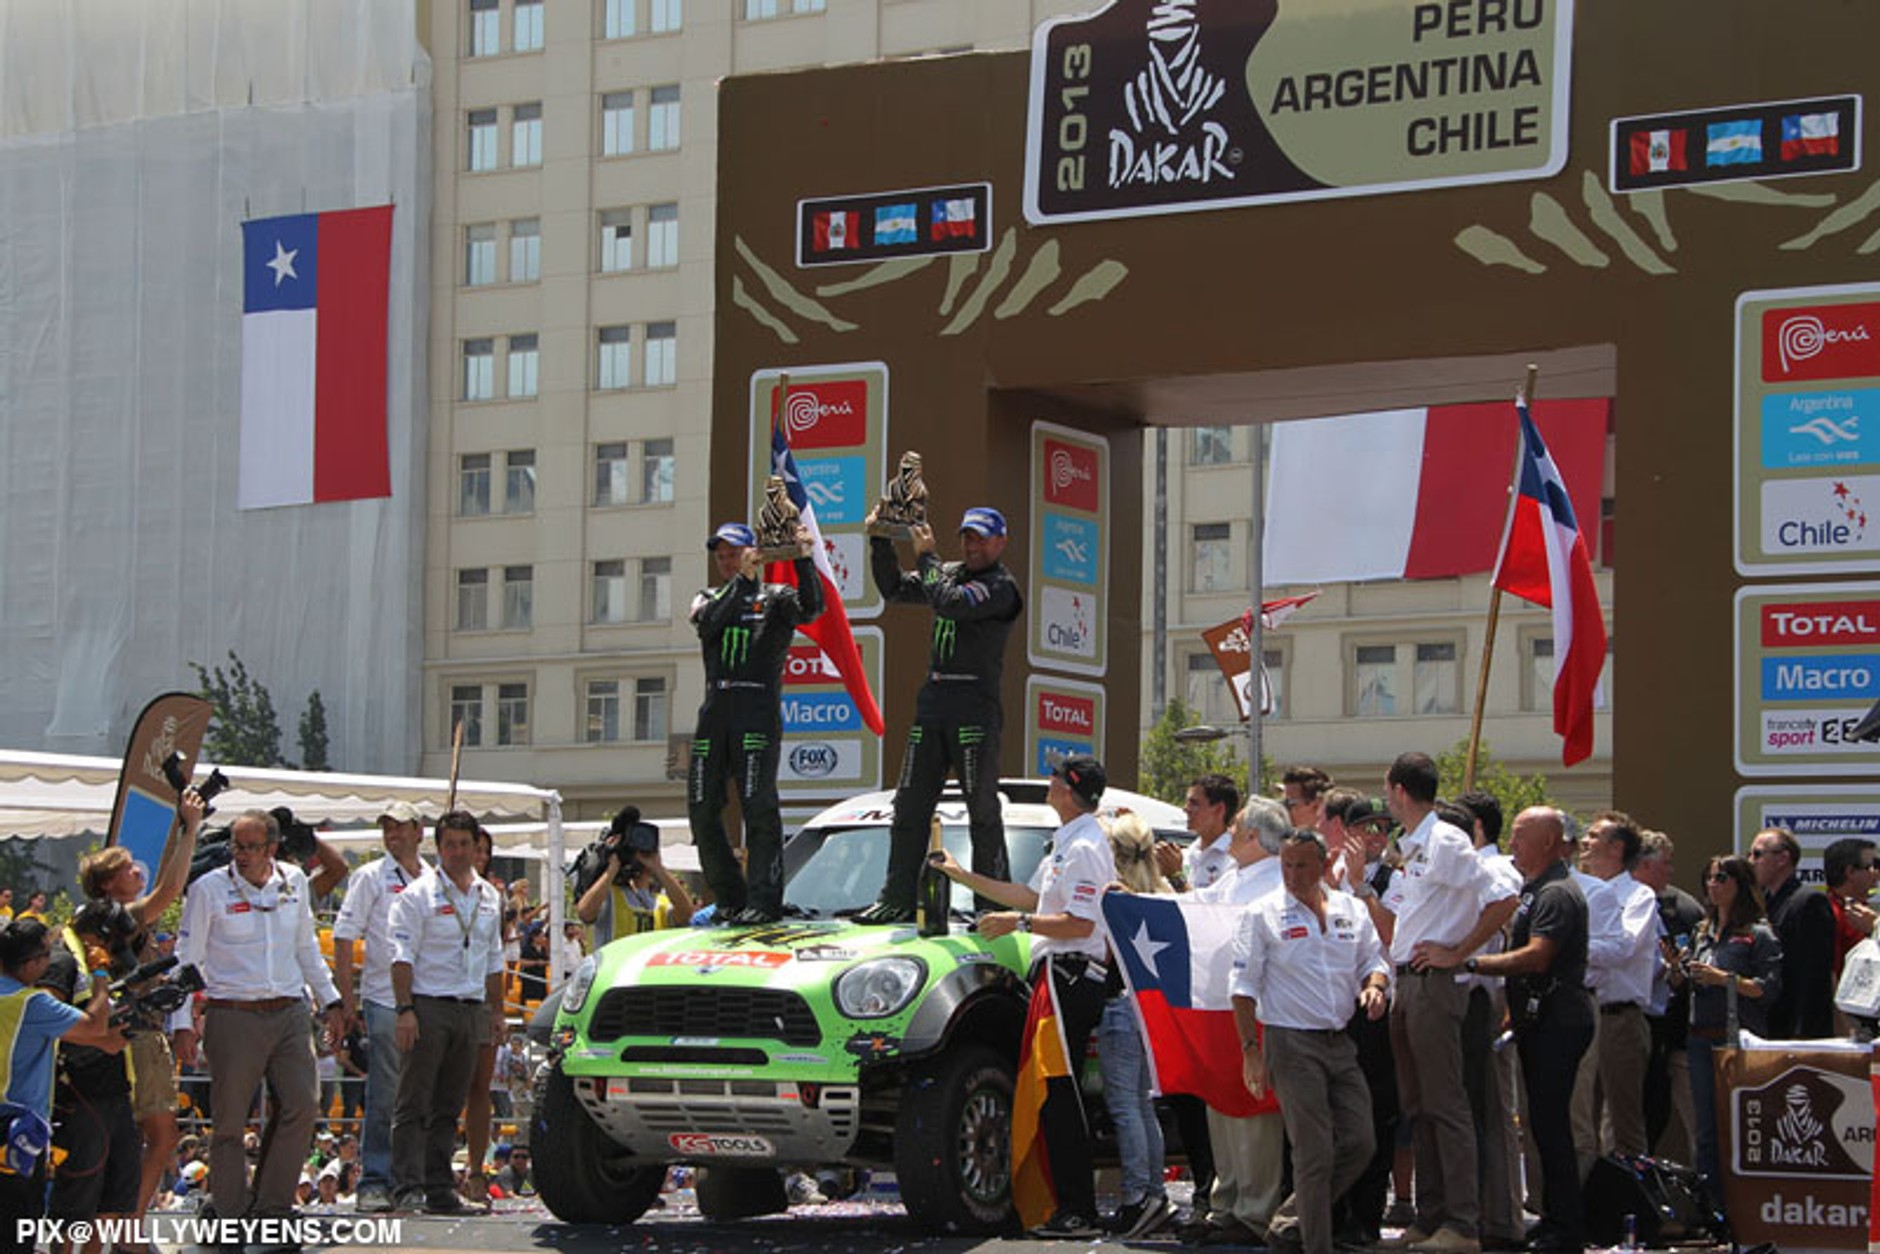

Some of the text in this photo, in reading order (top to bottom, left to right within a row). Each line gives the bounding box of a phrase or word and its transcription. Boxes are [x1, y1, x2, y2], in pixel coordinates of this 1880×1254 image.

[1413, 0, 1544, 42] PERU
[1270, 49, 1542, 115] ARGENTINA
[1057, 43, 1092, 192] 2013
[1407, 107, 1539, 156] CHILE
[1109, 121, 1234, 188] DAKAR
[1779, 520, 1850, 546] Chile
[1770, 612, 1877, 635] TOTAL
[1777, 665, 1870, 690] Macro
[781, 701, 849, 722] Macro
[1043, 700, 1090, 726] TOTAL
[1768, 730, 1815, 748] sport
[800, 749, 827, 764] FOX
[1795, 819, 1879, 830] MICHELIN
[666, 951, 776, 967] TOTAL
[1747, 1100, 1761, 1162] 2013
[1843, 1126, 1876, 1143] AR
[1770, 1138, 1829, 1166] DAKAR
